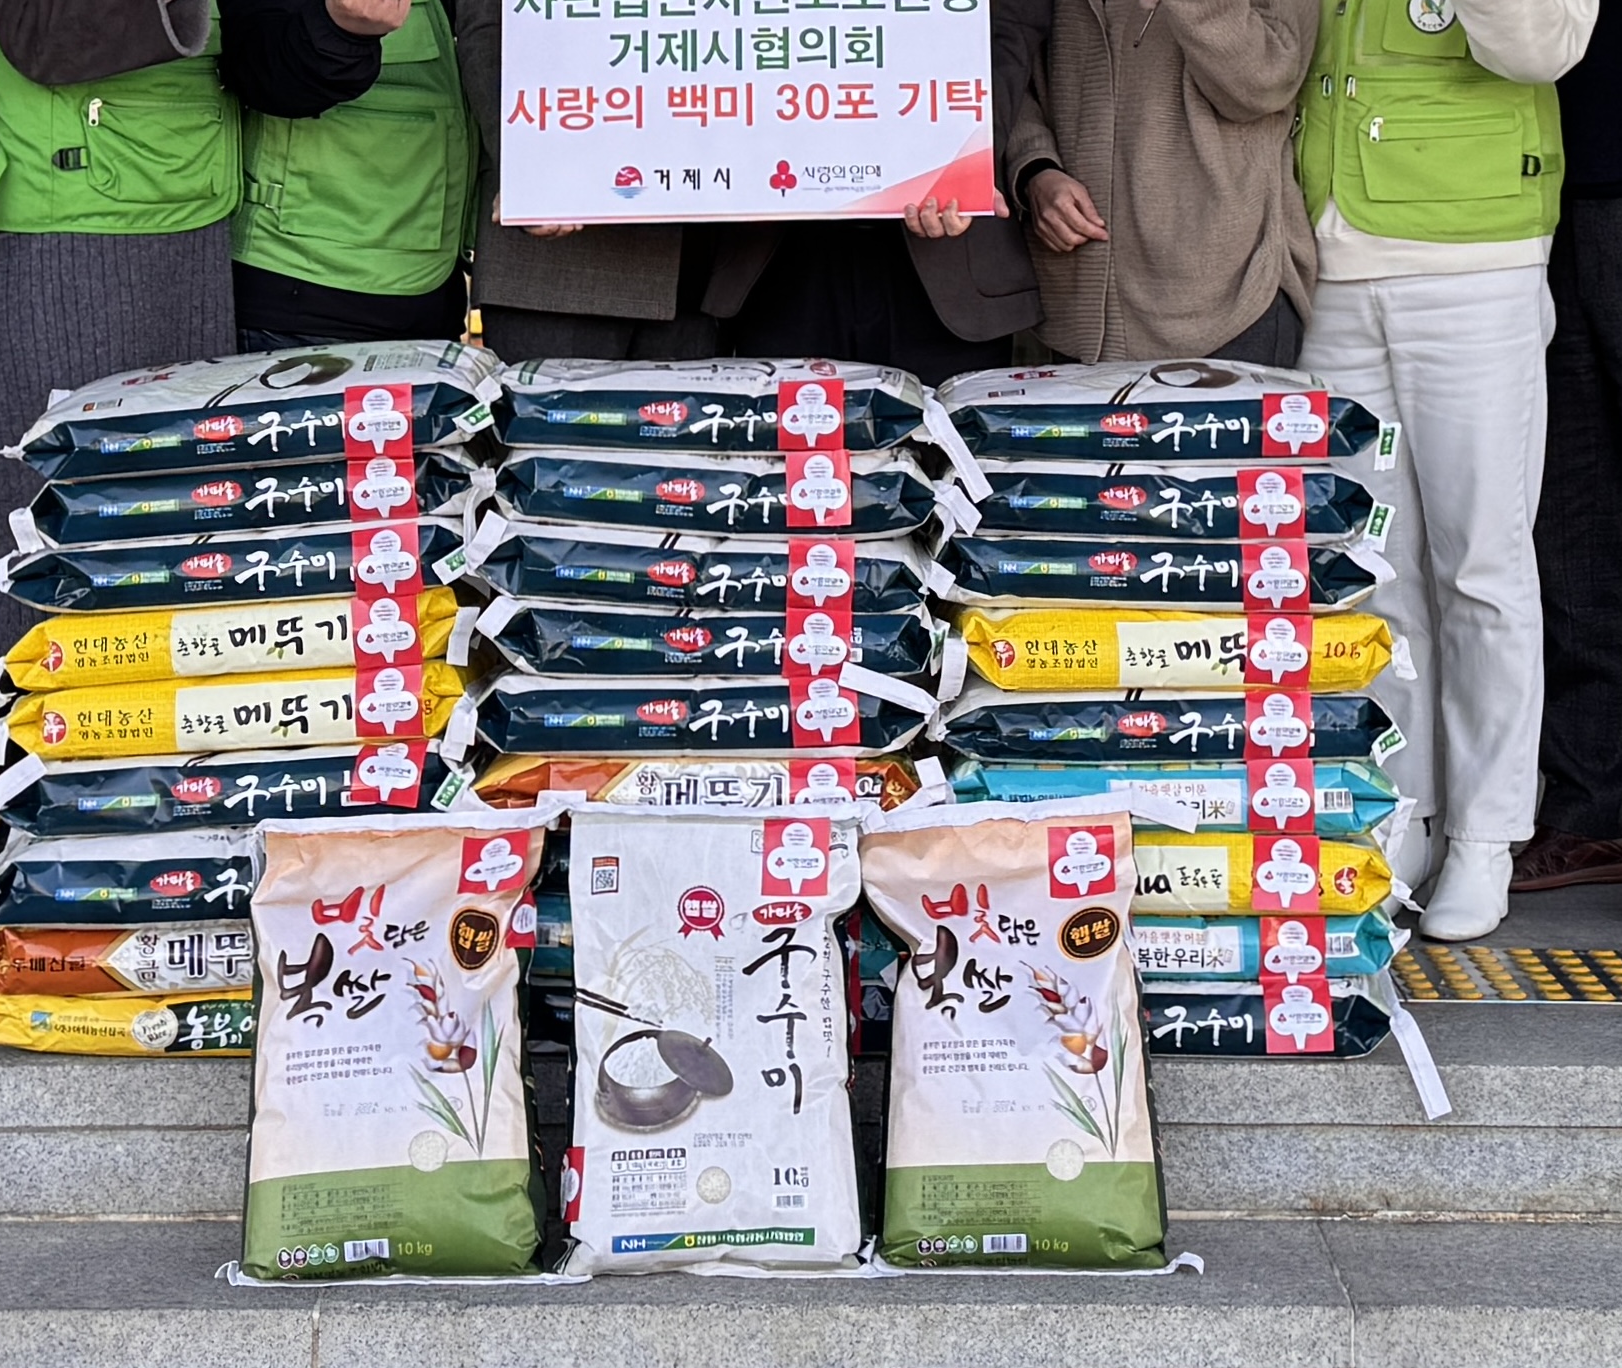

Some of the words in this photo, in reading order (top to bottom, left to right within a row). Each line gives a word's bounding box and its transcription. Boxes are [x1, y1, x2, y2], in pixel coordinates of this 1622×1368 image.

[608, 25, 884, 73] 거제시협의회
[507, 85, 643, 131] 사랑의
[667, 82, 753, 127] 백미
[776, 83, 879, 121] 30포
[898, 78, 988, 122] 기탁
[248, 411, 345, 452] 구수미
[1152, 412, 1250, 451] 구수미
[245, 477, 347, 519] 구수미
[235, 550, 336, 592] 구수미
[1140, 552, 1239, 593] 구수미
[229, 616, 347, 656] 메뚜기
[714, 627, 786, 668] 구수
[1176, 631, 1249, 673] 메뚜
[233, 696, 352, 736] 메뚜기
[689, 699, 789, 741] 구수미
[1169, 711, 1245, 753] 구수
[224, 774, 328, 817] 구수미
[204, 868, 254, 910] 구
[457, 921, 494, 953] 햅쌀
[1069, 918, 1112, 946] 햅쌀
[167, 932, 251, 977] 메뚜
[742, 926, 818, 1115] 구수미
[1153, 1006, 1254, 1048] 구수미
